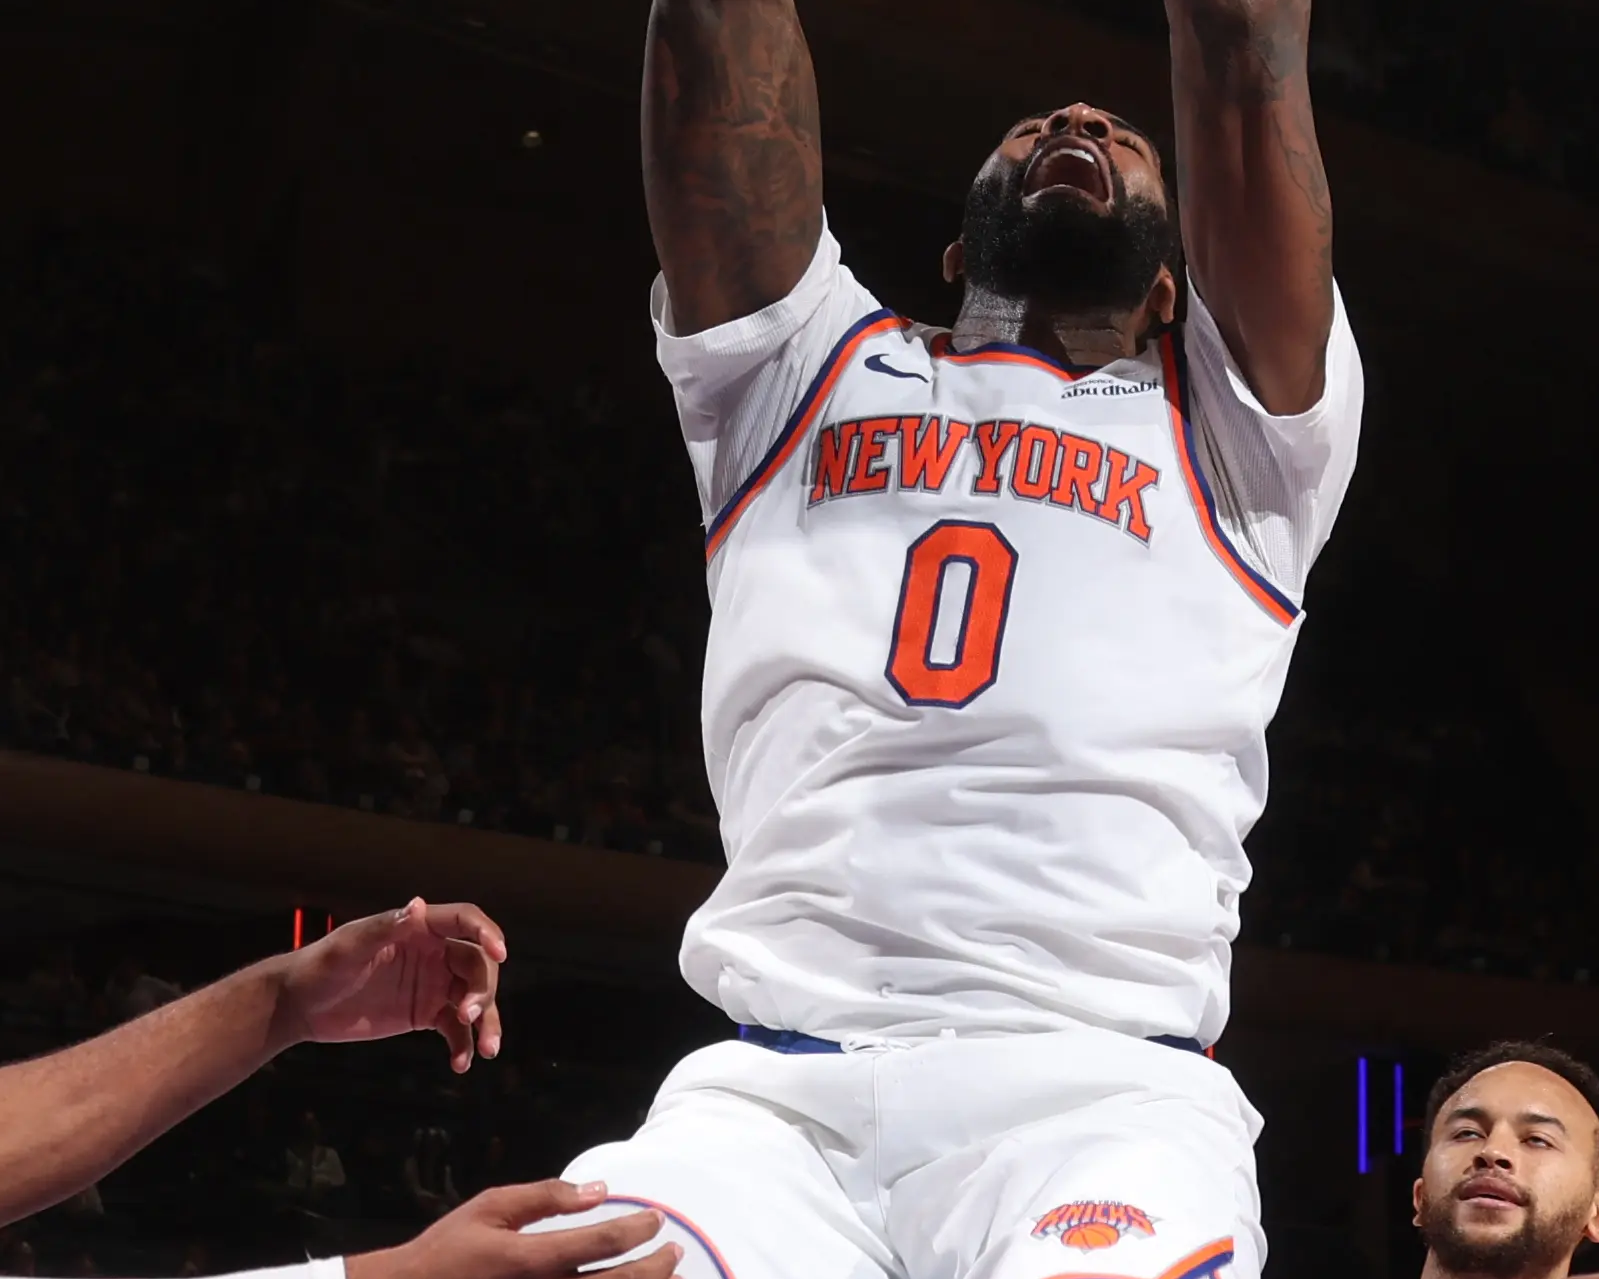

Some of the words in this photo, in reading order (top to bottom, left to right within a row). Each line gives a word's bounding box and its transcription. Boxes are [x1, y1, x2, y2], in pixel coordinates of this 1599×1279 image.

[1061, 387, 1099, 399] abu
[1102, 378, 1159, 396] dhabi
[808, 413, 973, 510] NEW
[971, 418, 1162, 548] YORK
[885, 519, 1019, 710] 0
